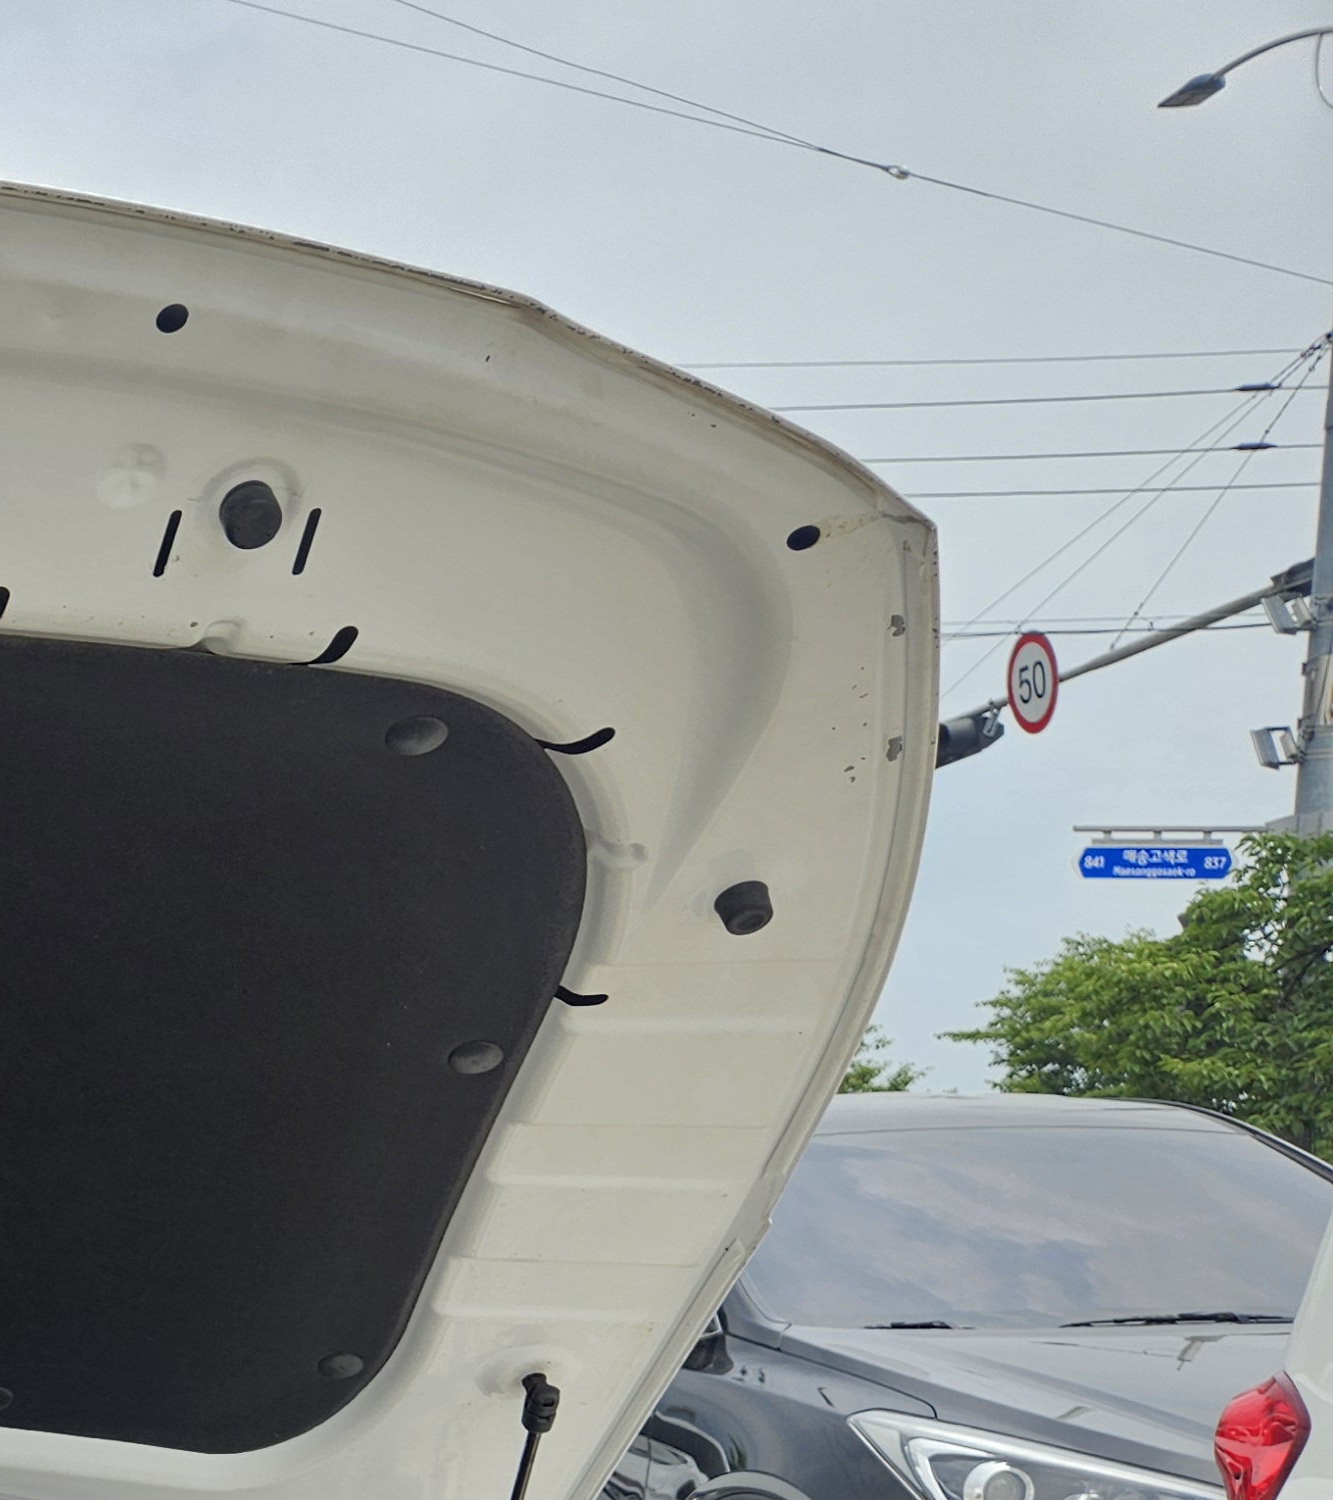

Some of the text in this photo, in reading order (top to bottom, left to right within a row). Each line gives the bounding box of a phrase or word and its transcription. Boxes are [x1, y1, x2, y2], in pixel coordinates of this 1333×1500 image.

[1018, 660, 1046, 704] 50
[1083, 855, 1105, 869] 841
[1122, 848, 1189, 866] 매송고색로
[1203, 856, 1227, 870] 837
